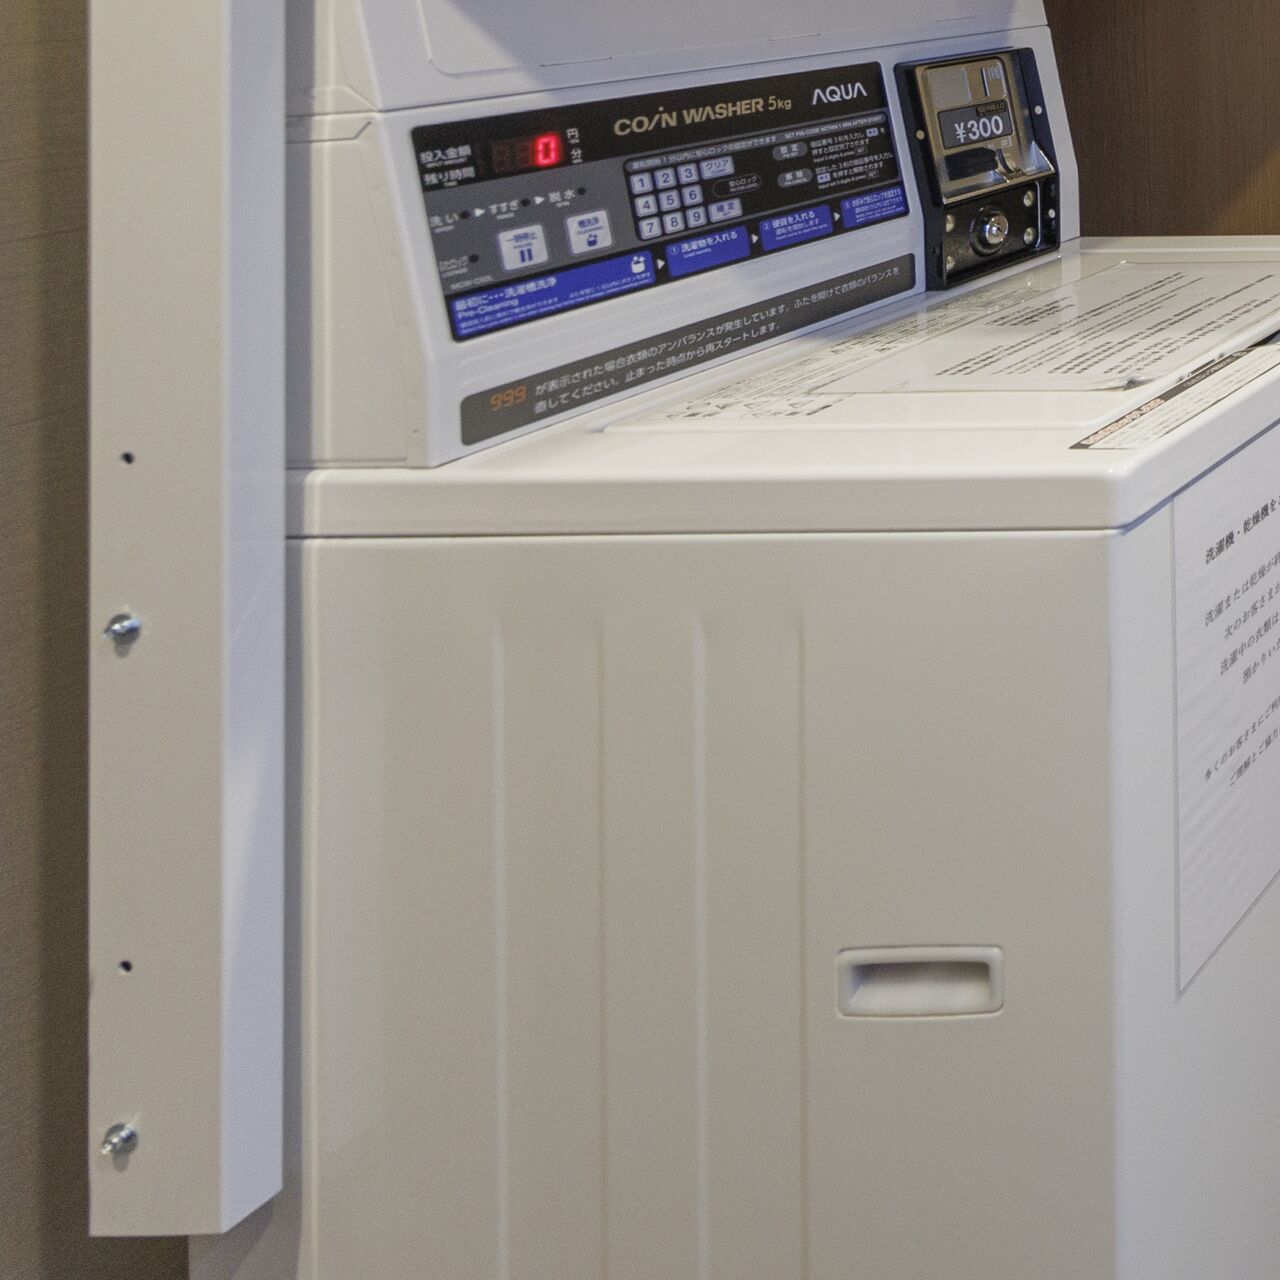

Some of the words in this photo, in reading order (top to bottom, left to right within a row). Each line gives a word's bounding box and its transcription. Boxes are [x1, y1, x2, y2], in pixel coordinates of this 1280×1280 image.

[812, 81, 868, 107] AQUA
[613, 106, 677, 136] COIN
[683, 97, 764, 125] WASHER
[767, 95, 792, 112] 5kg
[566, 128, 579, 139] 円
[954, 115, 1004, 144] ¥300
[420, 144, 472, 165] 投入金額
[535, 133, 560, 166] 0
[571, 148, 583, 159] 分
[423, 166, 476, 186] 残り時間
[638, 177, 645, 188] 1
[662, 173, 670, 184] 2
[684, 168, 693, 179] 3
[705, 159, 729, 171] クリア
[548, 188, 576, 203] 脱水
[642, 200, 651, 210] 4
[666, 194, 674, 206] 5
[688, 189, 697, 201] 6
[489, 199, 519, 216] すすぎ
[647, 222, 655, 233] 7
[670, 217, 679, 228] 8
[692, 212, 701, 223] 9
[772, 210, 816, 229] 硬貨を入れる
[681, 231, 738, 253] 洗濯物を入れる
[457, 297, 519, 319] Pre-Cleaning
[489, 384, 528, 412] 999
